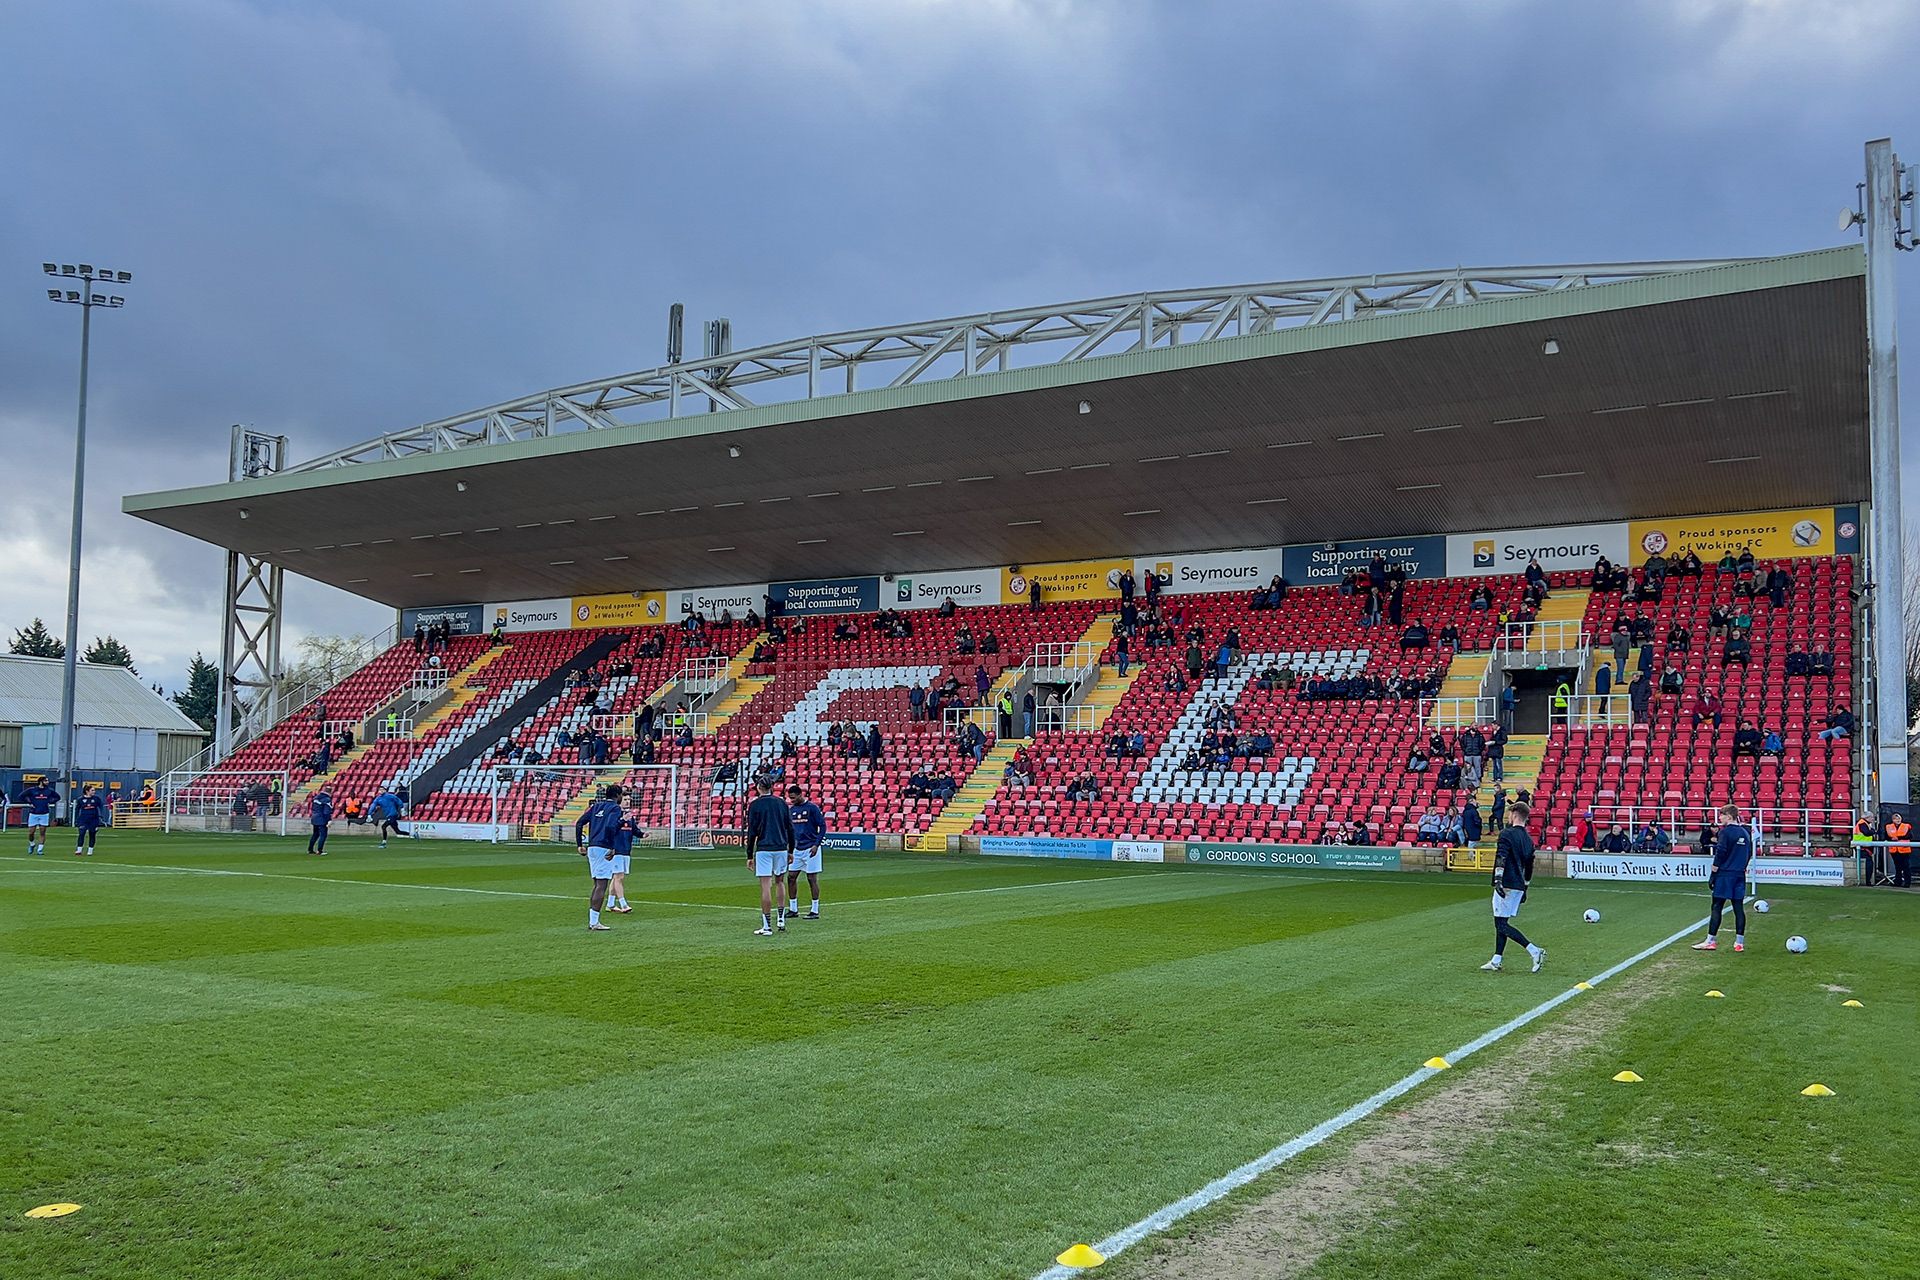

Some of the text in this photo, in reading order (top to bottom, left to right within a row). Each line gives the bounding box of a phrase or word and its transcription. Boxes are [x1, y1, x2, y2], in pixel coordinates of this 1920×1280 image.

[1680, 526, 1778, 538] Proud sponsors
[1680, 539, 1763, 551] of Woking FC
[1312, 546, 1414, 564] Supporting our
[1504, 543, 1600, 563] Seymours
[1181, 566, 1258, 583] Seymours
[1307, 560, 1419, 578] local comuity
[1061, 573, 1097, 582] sponsors
[788, 585, 858, 599] Supporting our
[918, 584, 982, 599] Seymours
[698, 597, 752, 610] Seymours
[785, 596, 862, 610] local community
[417, 611, 454, 623] Supporting
[511, 612, 558, 625] Seymours
[713, 834, 748, 845] vanaa
[821, 836, 861, 848] Seymours
[1206, 850, 1320, 864] GORDON'S SCHOOL
[1571, 860, 1706, 876] Woking News & Mail
